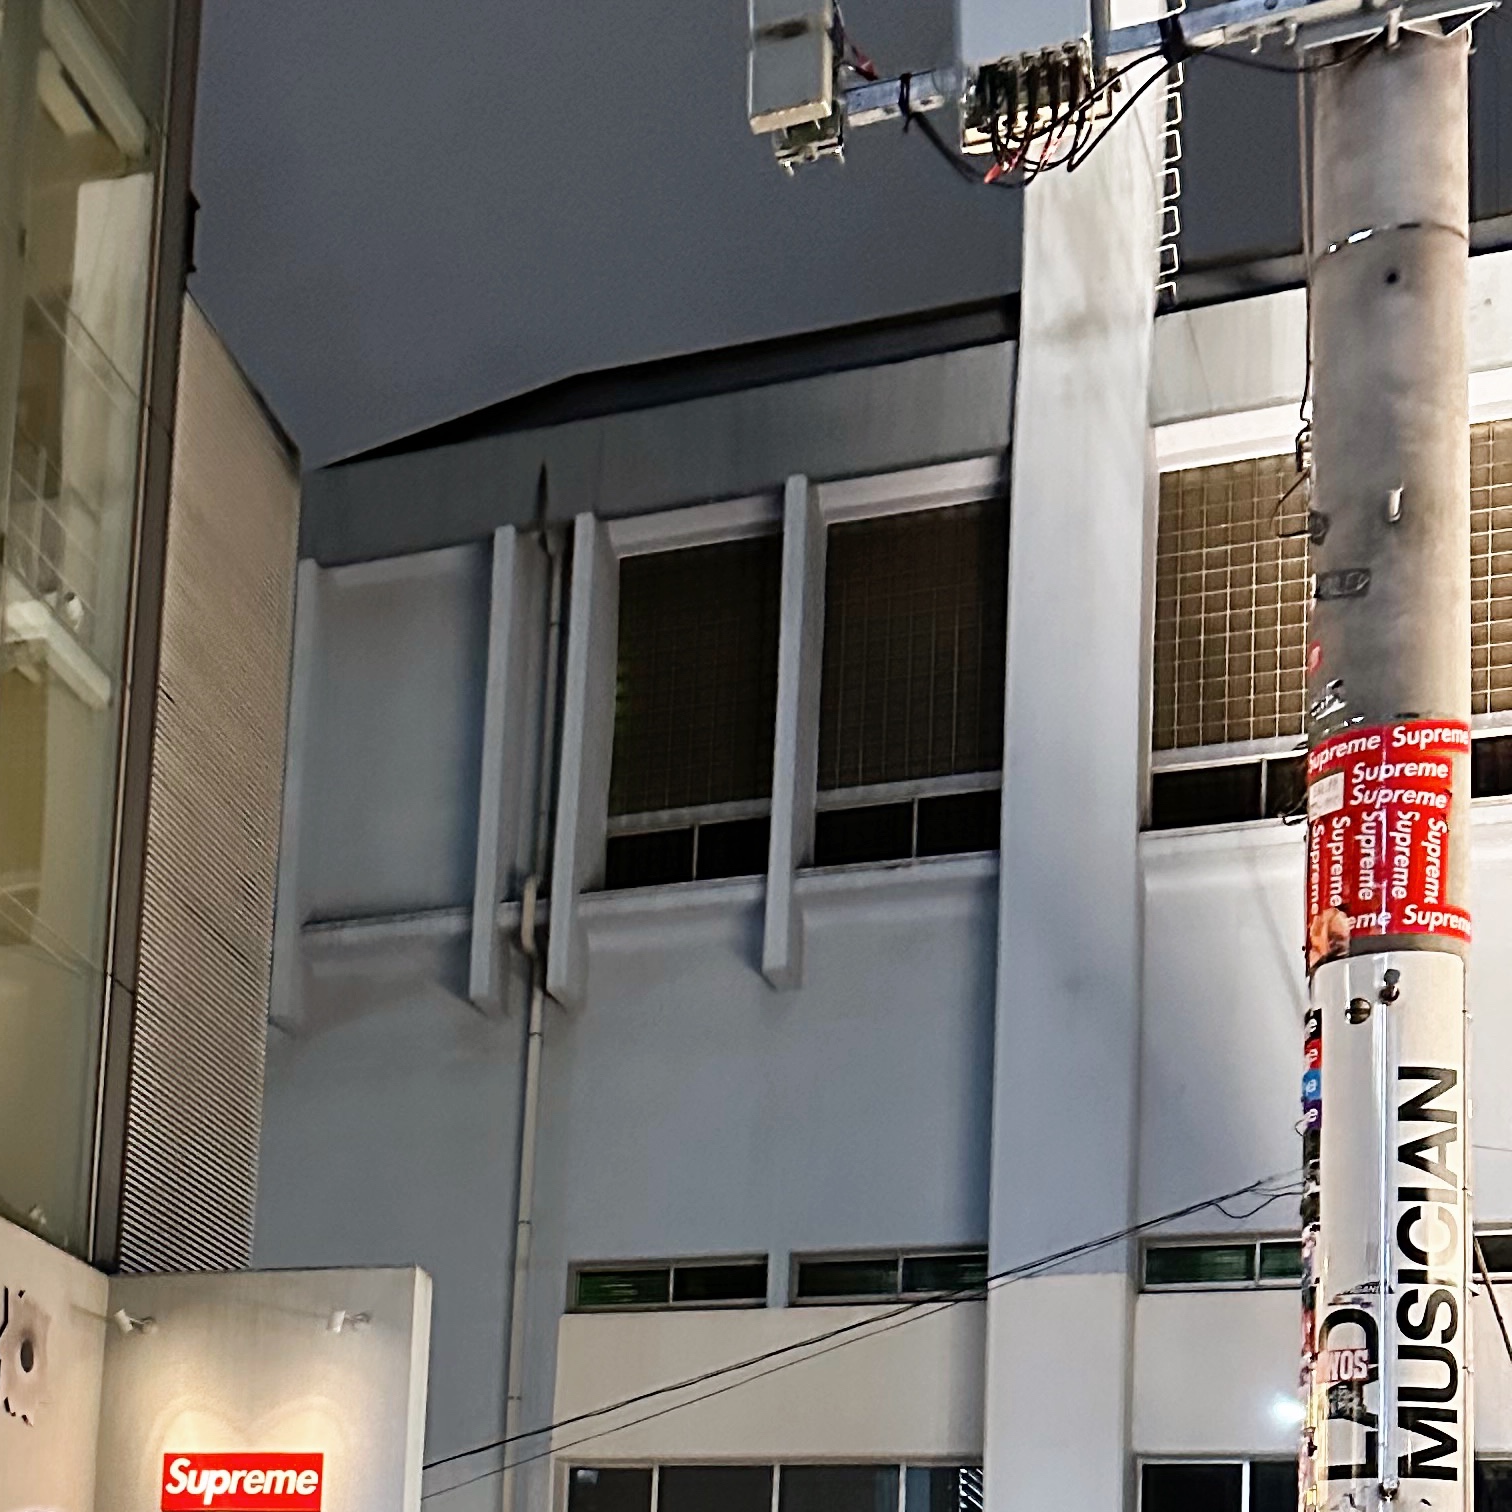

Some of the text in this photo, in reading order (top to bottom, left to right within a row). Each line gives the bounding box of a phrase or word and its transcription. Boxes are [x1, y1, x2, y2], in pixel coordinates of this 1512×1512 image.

[1309, 734, 1382, 773] Supreme
[1351, 761, 1449, 785] Supreme
[1350, 784, 1448, 809] Supreme
[1327, 816, 1351, 907] Supreme
[1355, 812, 1382, 901] Supreme
[1389, 811, 1420, 899] Supreme
[1402, 904, 1472, 932] Suprem
[1397, 1066, 1459, 1481] MUSICIAN
[1319, 1308, 1379, 1481] LAD
[165, 1458, 319, 1506] Supreme
